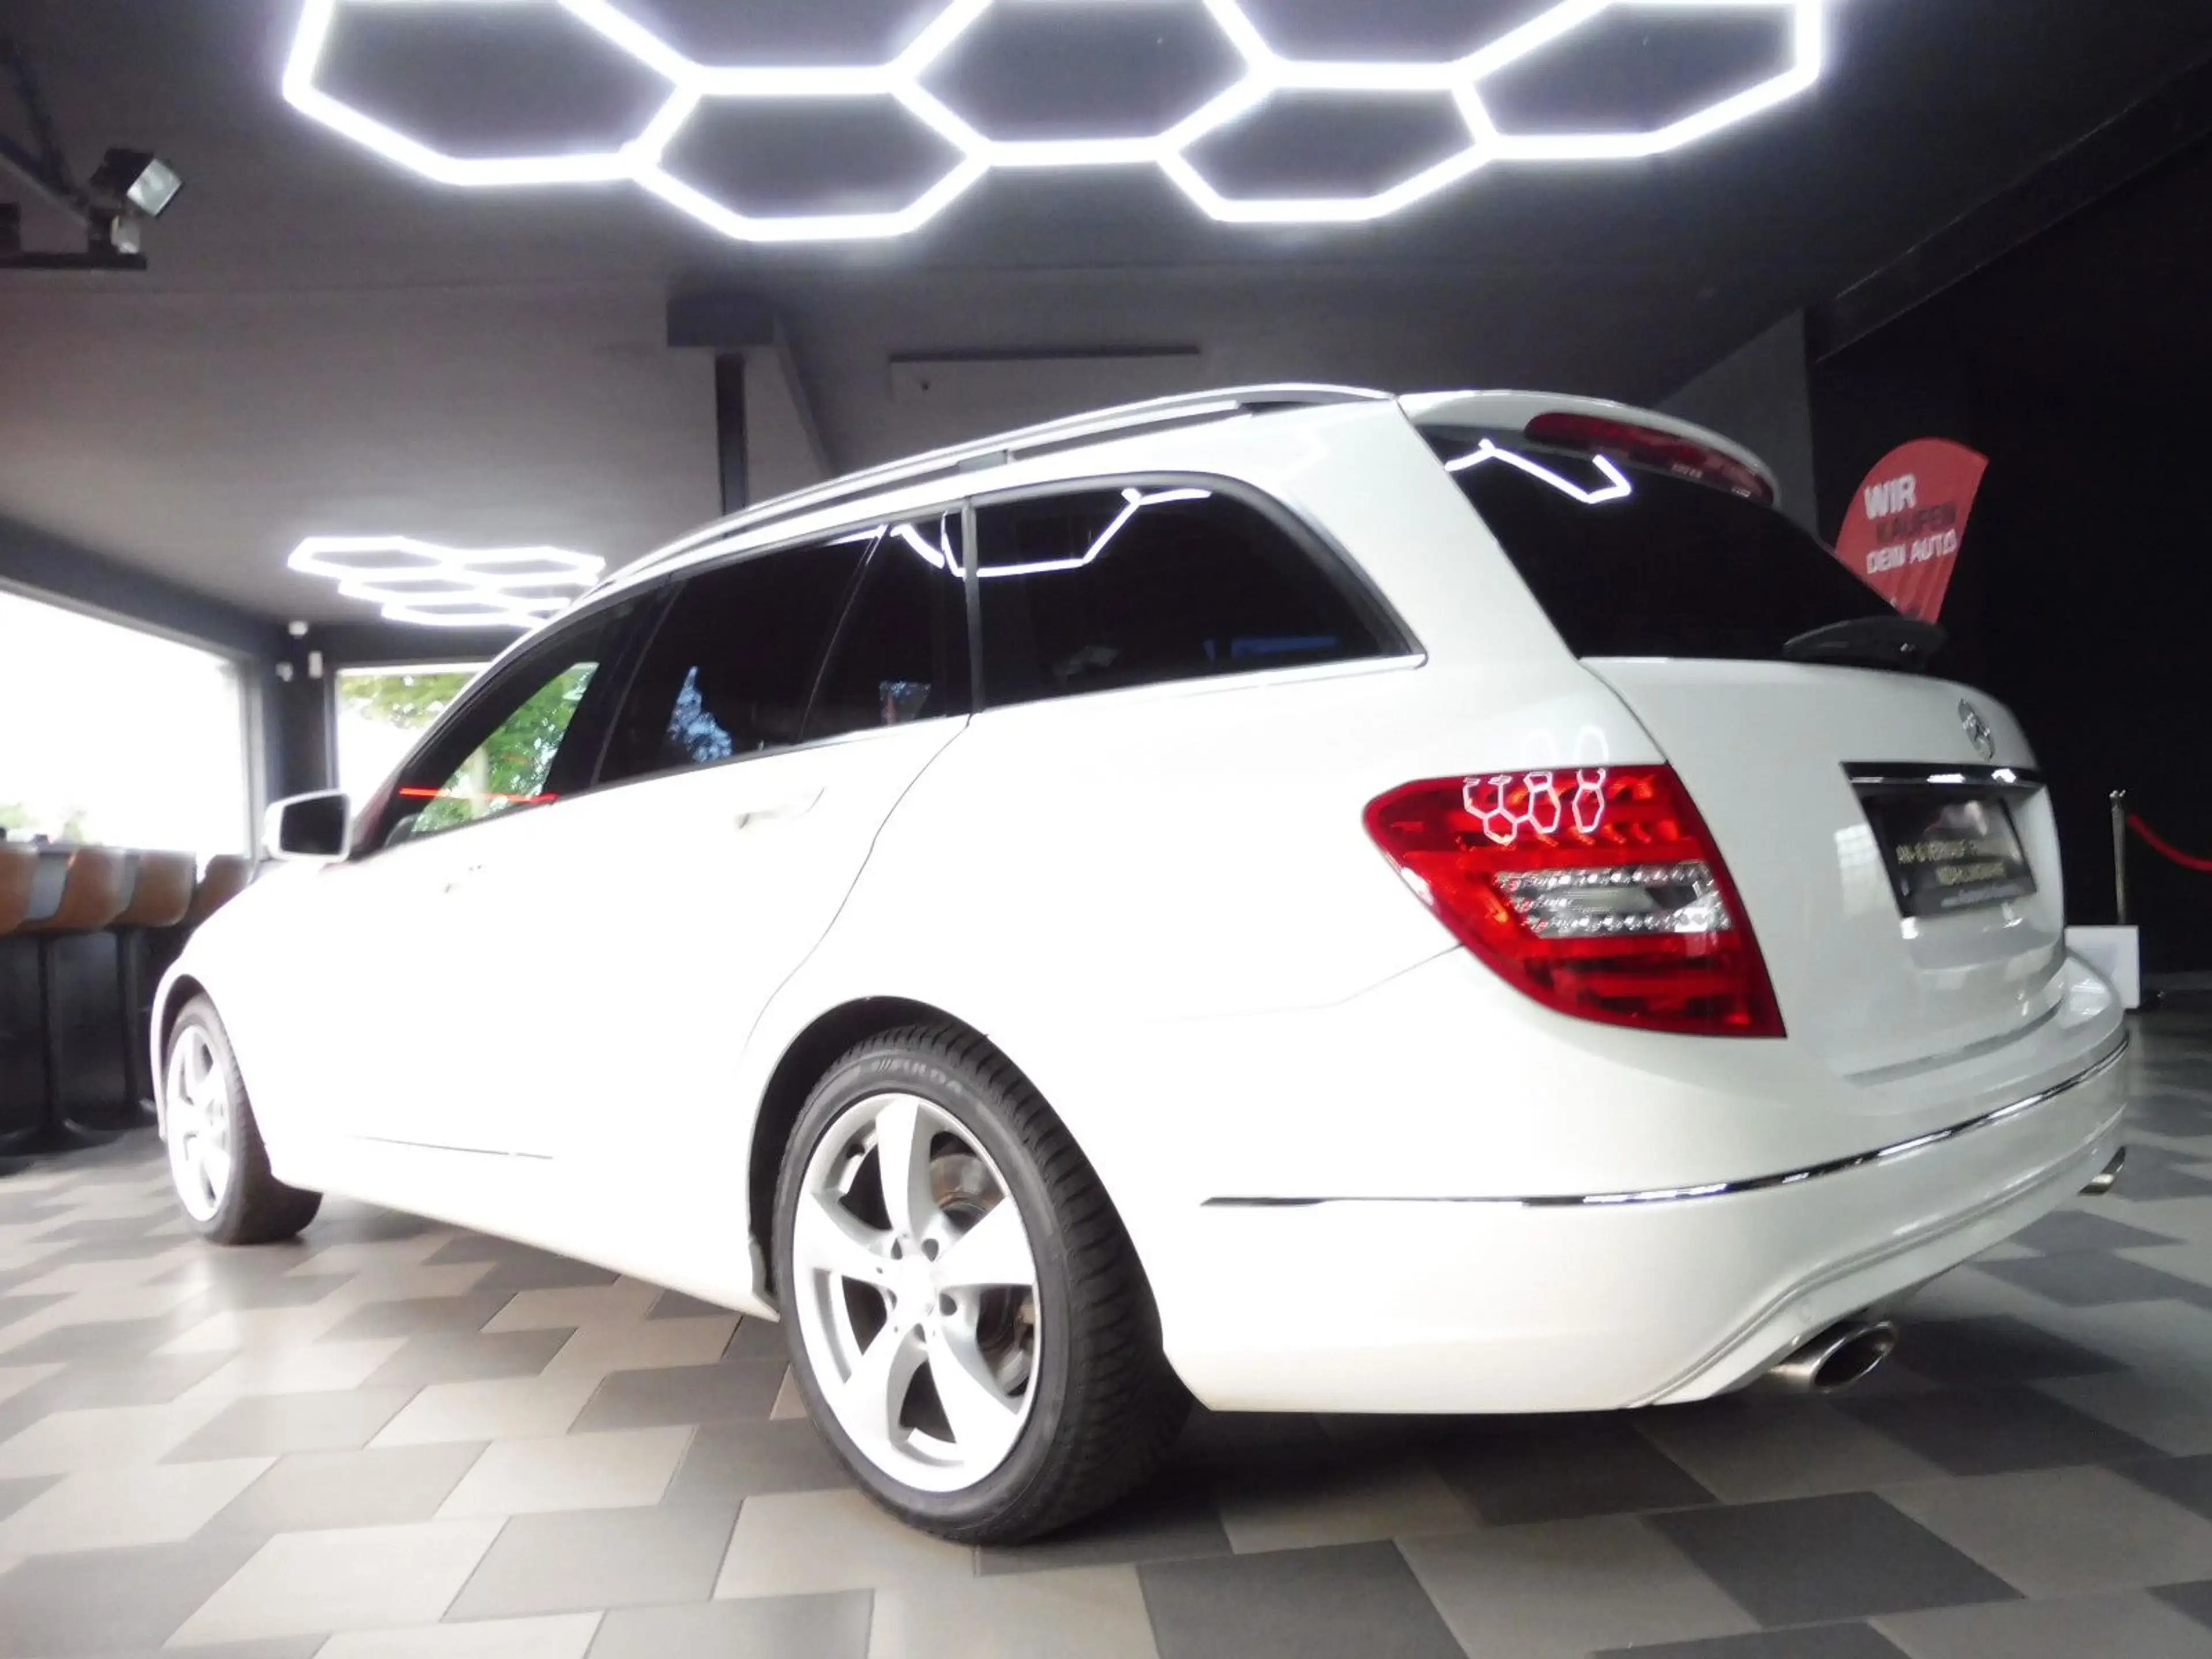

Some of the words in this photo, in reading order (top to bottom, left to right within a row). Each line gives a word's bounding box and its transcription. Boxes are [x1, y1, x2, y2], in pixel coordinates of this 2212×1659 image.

[1864, 474, 1916, 520] WIR
[1866, 543, 1906, 574] DEIN
[1910, 528, 1957, 564] AUTO
